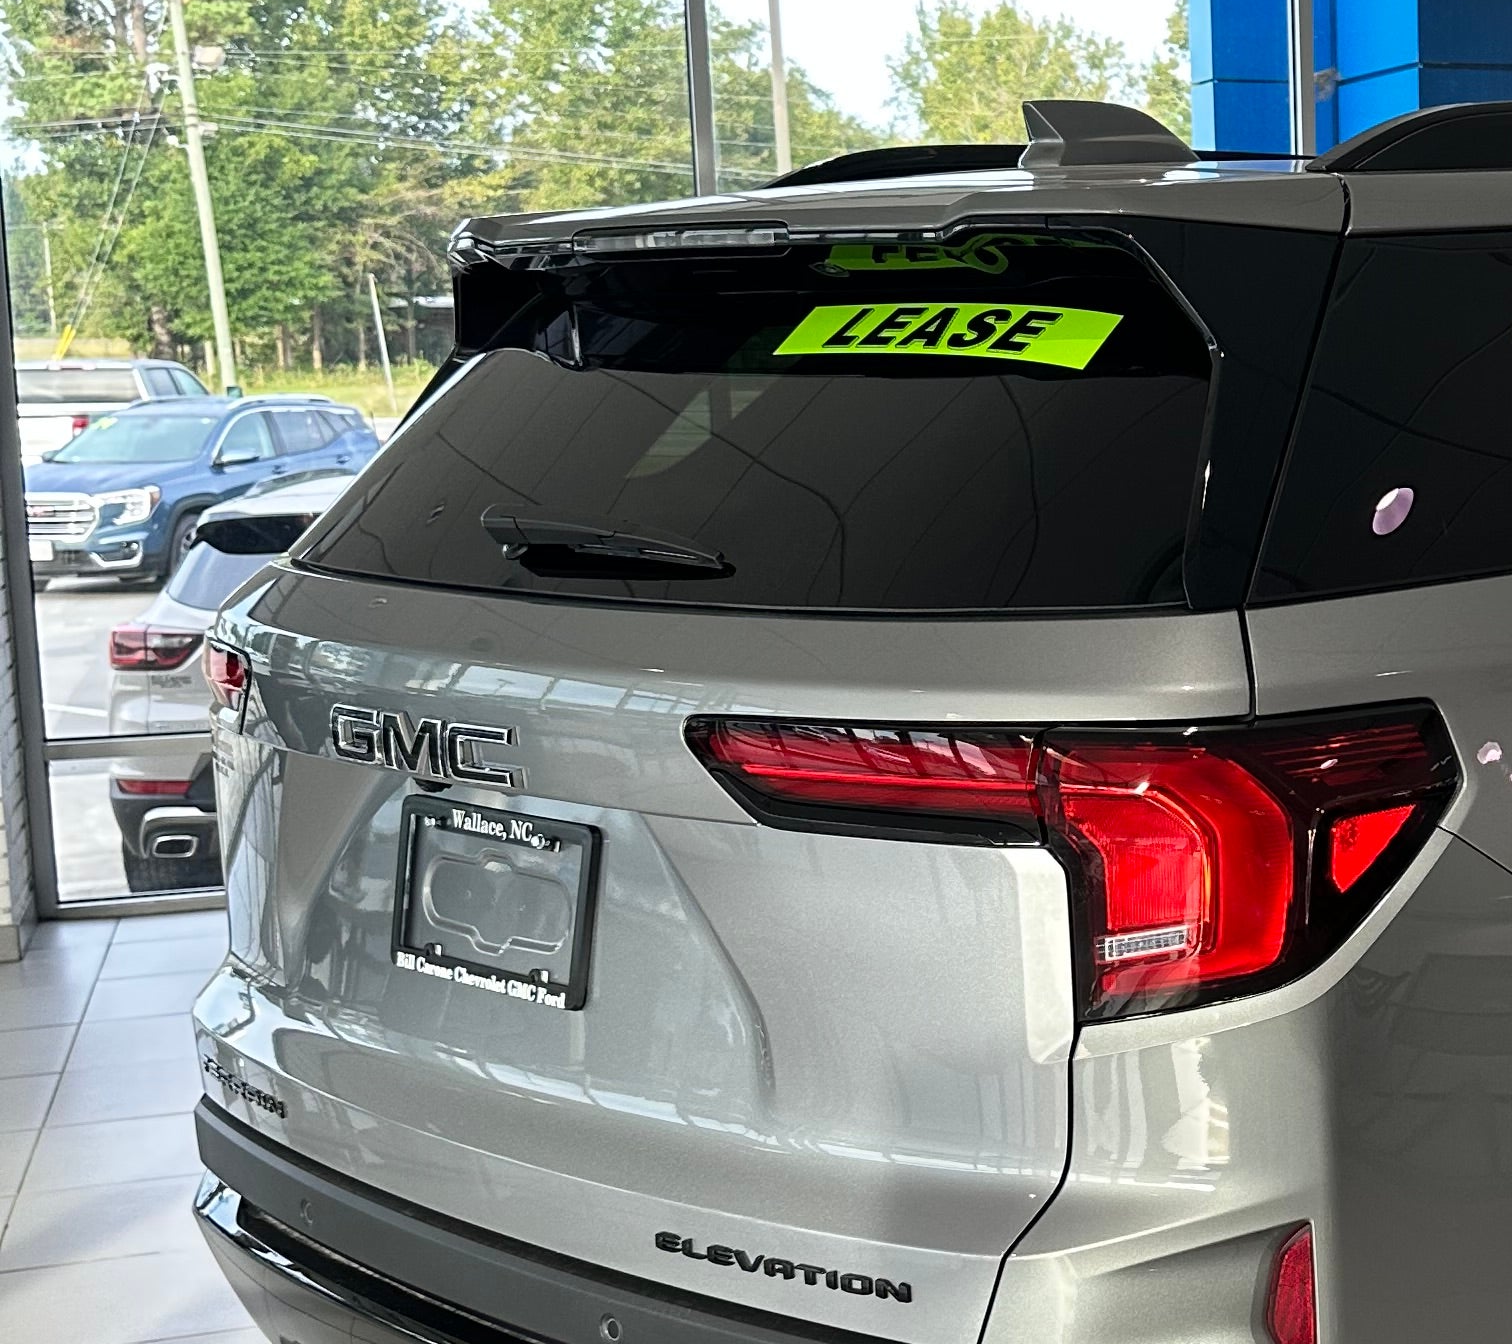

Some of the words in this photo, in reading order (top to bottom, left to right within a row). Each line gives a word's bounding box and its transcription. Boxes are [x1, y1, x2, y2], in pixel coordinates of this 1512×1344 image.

[822, 306, 1063, 355] LEASE
[329, 702, 529, 789] GMC
[452, 808, 507, 841] Wallace,
[509, 819, 534, 841] NC
[396, 951, 416, 970] Bill
[416, 956, 454, 981] Carone
[454, 966, 507, 994] Chevrolet
[507, 979, 537, 1002] GMC
[536, 987, 566, 1010] Ford
[655, 1230, 912, 1304] ELEVATION
